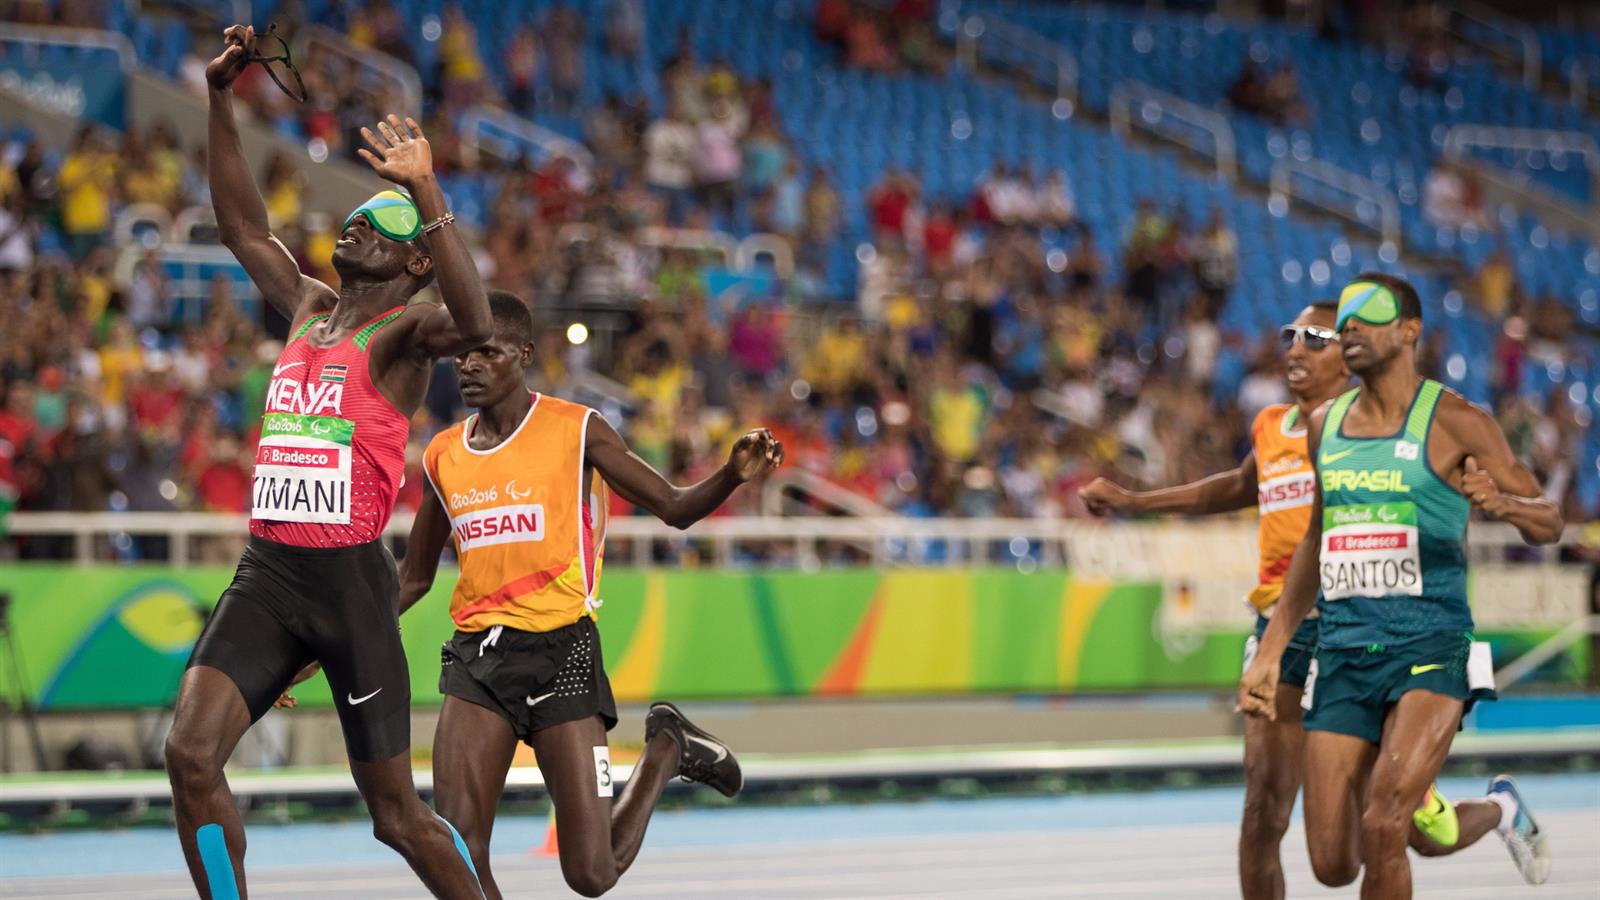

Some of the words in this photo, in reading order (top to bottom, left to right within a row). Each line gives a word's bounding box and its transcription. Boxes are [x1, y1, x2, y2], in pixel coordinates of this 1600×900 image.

[265, 378, 344, 415] KENYA
[267, 417, 303, 433] Rio2016
[271, 449, 328, 465] Bradesco
[1258, 479, 1316, 505] NISSA
[1322, 470, 1410, 492] BRASIL
[450, 485, 498, 511] Rio2016
[457, 512, 537, 542] NISSAN
[1346, 536, 1399, 549] Bradesco
[1321, 559, 1417, 591] SANTOS
[598, 758, 611, 787] 3
